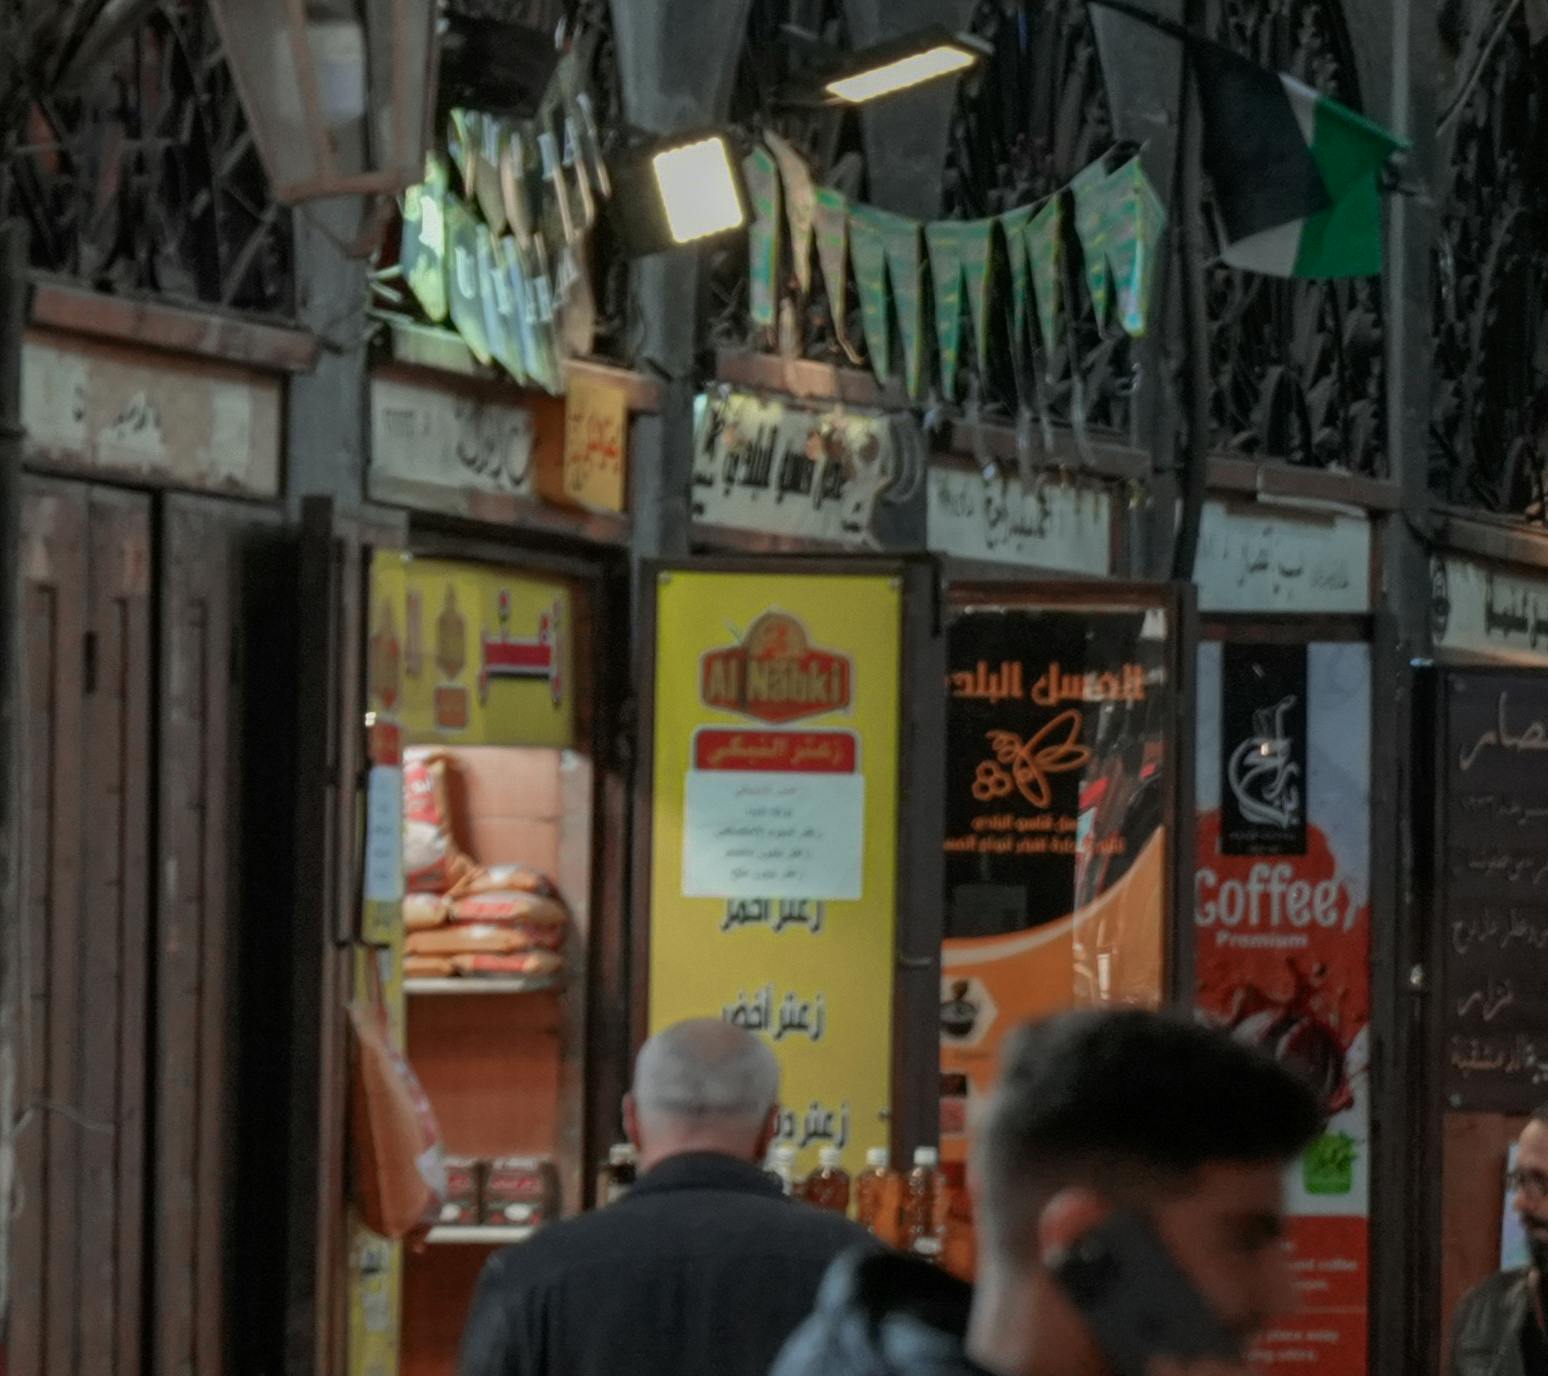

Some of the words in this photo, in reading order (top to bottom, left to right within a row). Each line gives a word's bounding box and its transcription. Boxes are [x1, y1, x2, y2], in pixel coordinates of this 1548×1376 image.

[1031, 661, 1145, 707] العسل
[1194, 862, 1340, 928] Coffee
[1216, 931, 1309, 949] Premium
[773, 991, 825, 1041] زعتر
[799, 1101, 849, 1149] زعتر
